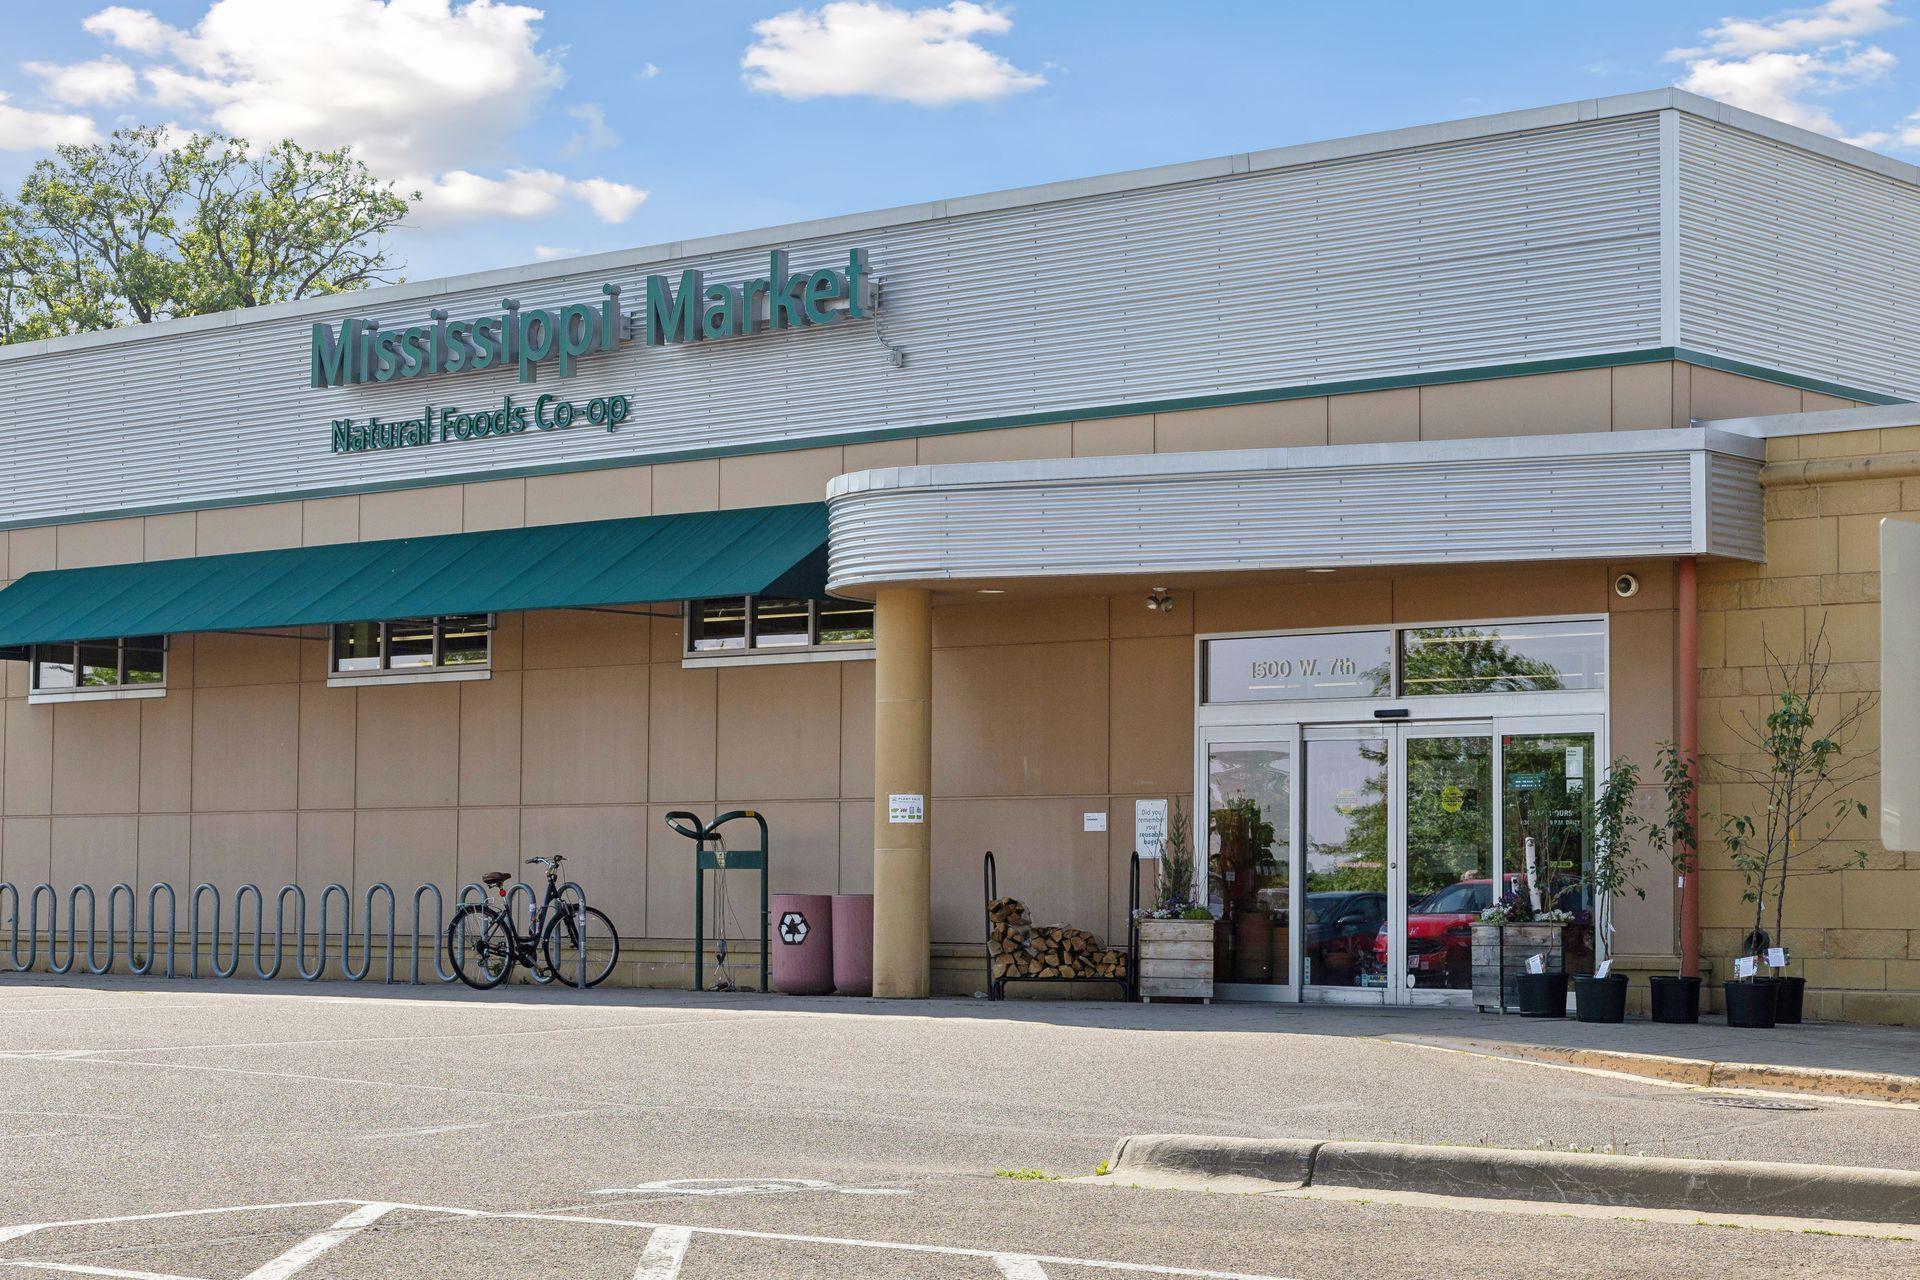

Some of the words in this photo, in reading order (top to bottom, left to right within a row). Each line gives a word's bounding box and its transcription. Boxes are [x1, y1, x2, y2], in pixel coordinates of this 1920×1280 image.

[311, 283, 619, 389] Mississippi
[647, 248, 870, 347] Market
[331, 406, 432, 454] Natural
[440, 396, 528, 443] Foods
[534, 394, 629, 433] Co-op
[1251, 659, 1292, 679] 1500
[1299, 659, 1321, 677] W.
[1329, 657, 1357, 676] 7th
